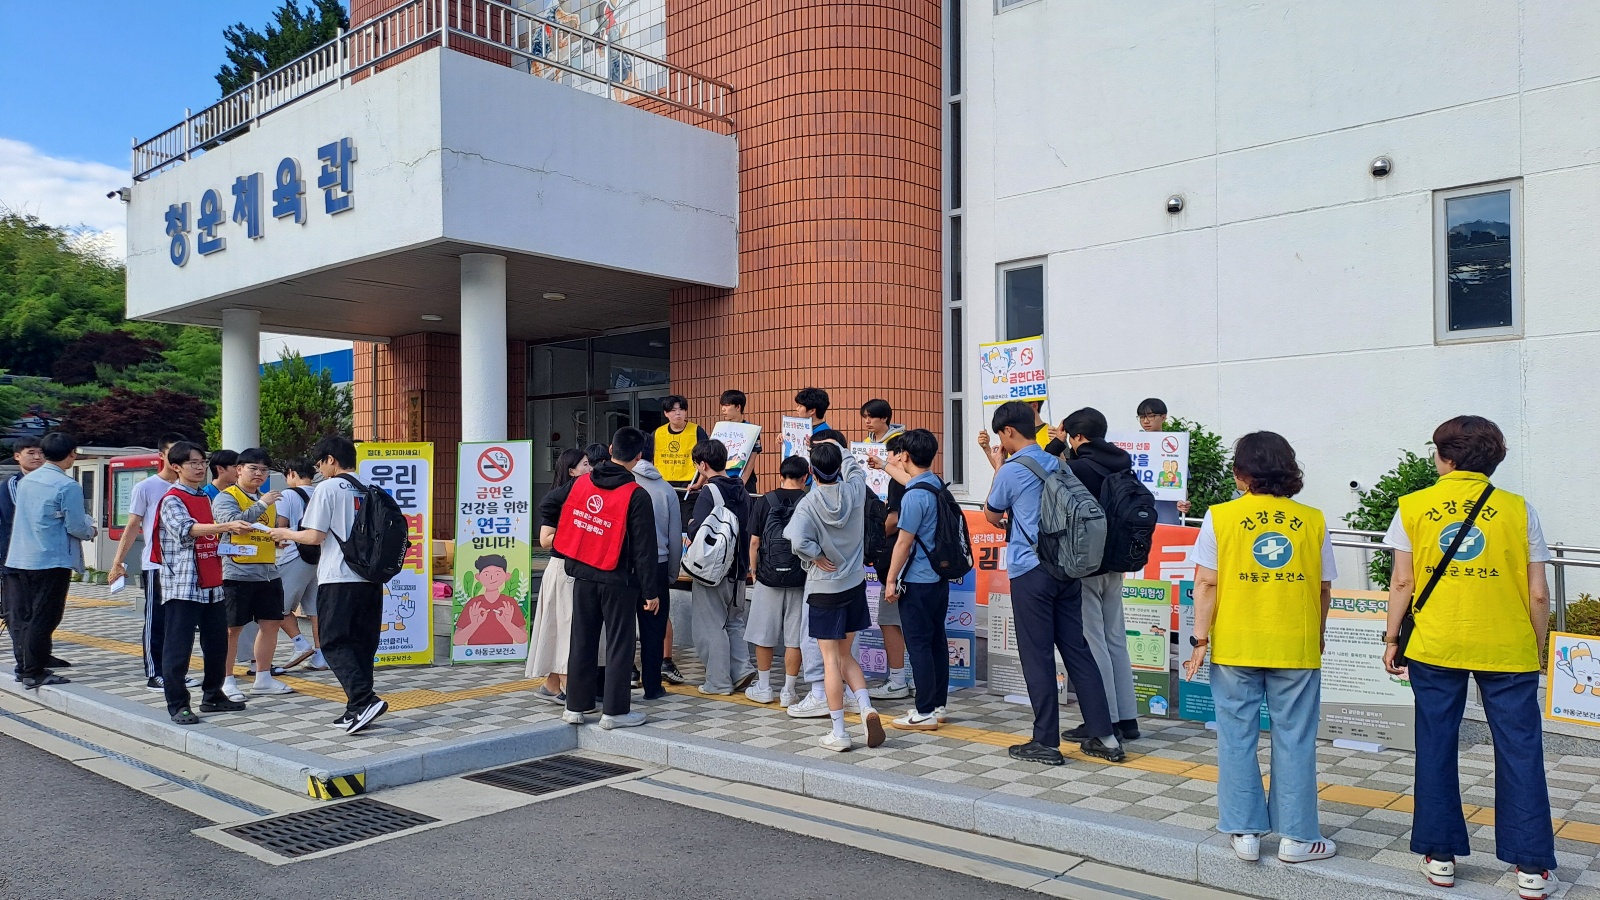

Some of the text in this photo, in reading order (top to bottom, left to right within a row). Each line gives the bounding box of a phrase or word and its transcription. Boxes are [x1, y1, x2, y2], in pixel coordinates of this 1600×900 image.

[164, 136, 358, 267] 청운체육관
[1009, 370, 1045, 384] 금연다짐
[1010, 383, 1046, 398] 건강다짐
[371, 465, 417, 485] 우리
[476, 486, 514, 499] 금연은
[460, 500, 529, 515] 건강을 위한
[477, 517, 512, 535] 연금
[1240, 510, 1304, 531] 건강증진
[472, 536, 516, 550] 입니다!
[972, 533, 995, 544] 생각해
[1238, 572, 1305, 582] 하동군 보건소
[1464, 568, 1499, 578] 보건소
[1121, 587, 1164, 600] 연의 위험성
[381, 654, 412, 662] 하동군보건소
[475, 647, 516, 656] 하동군보건소
